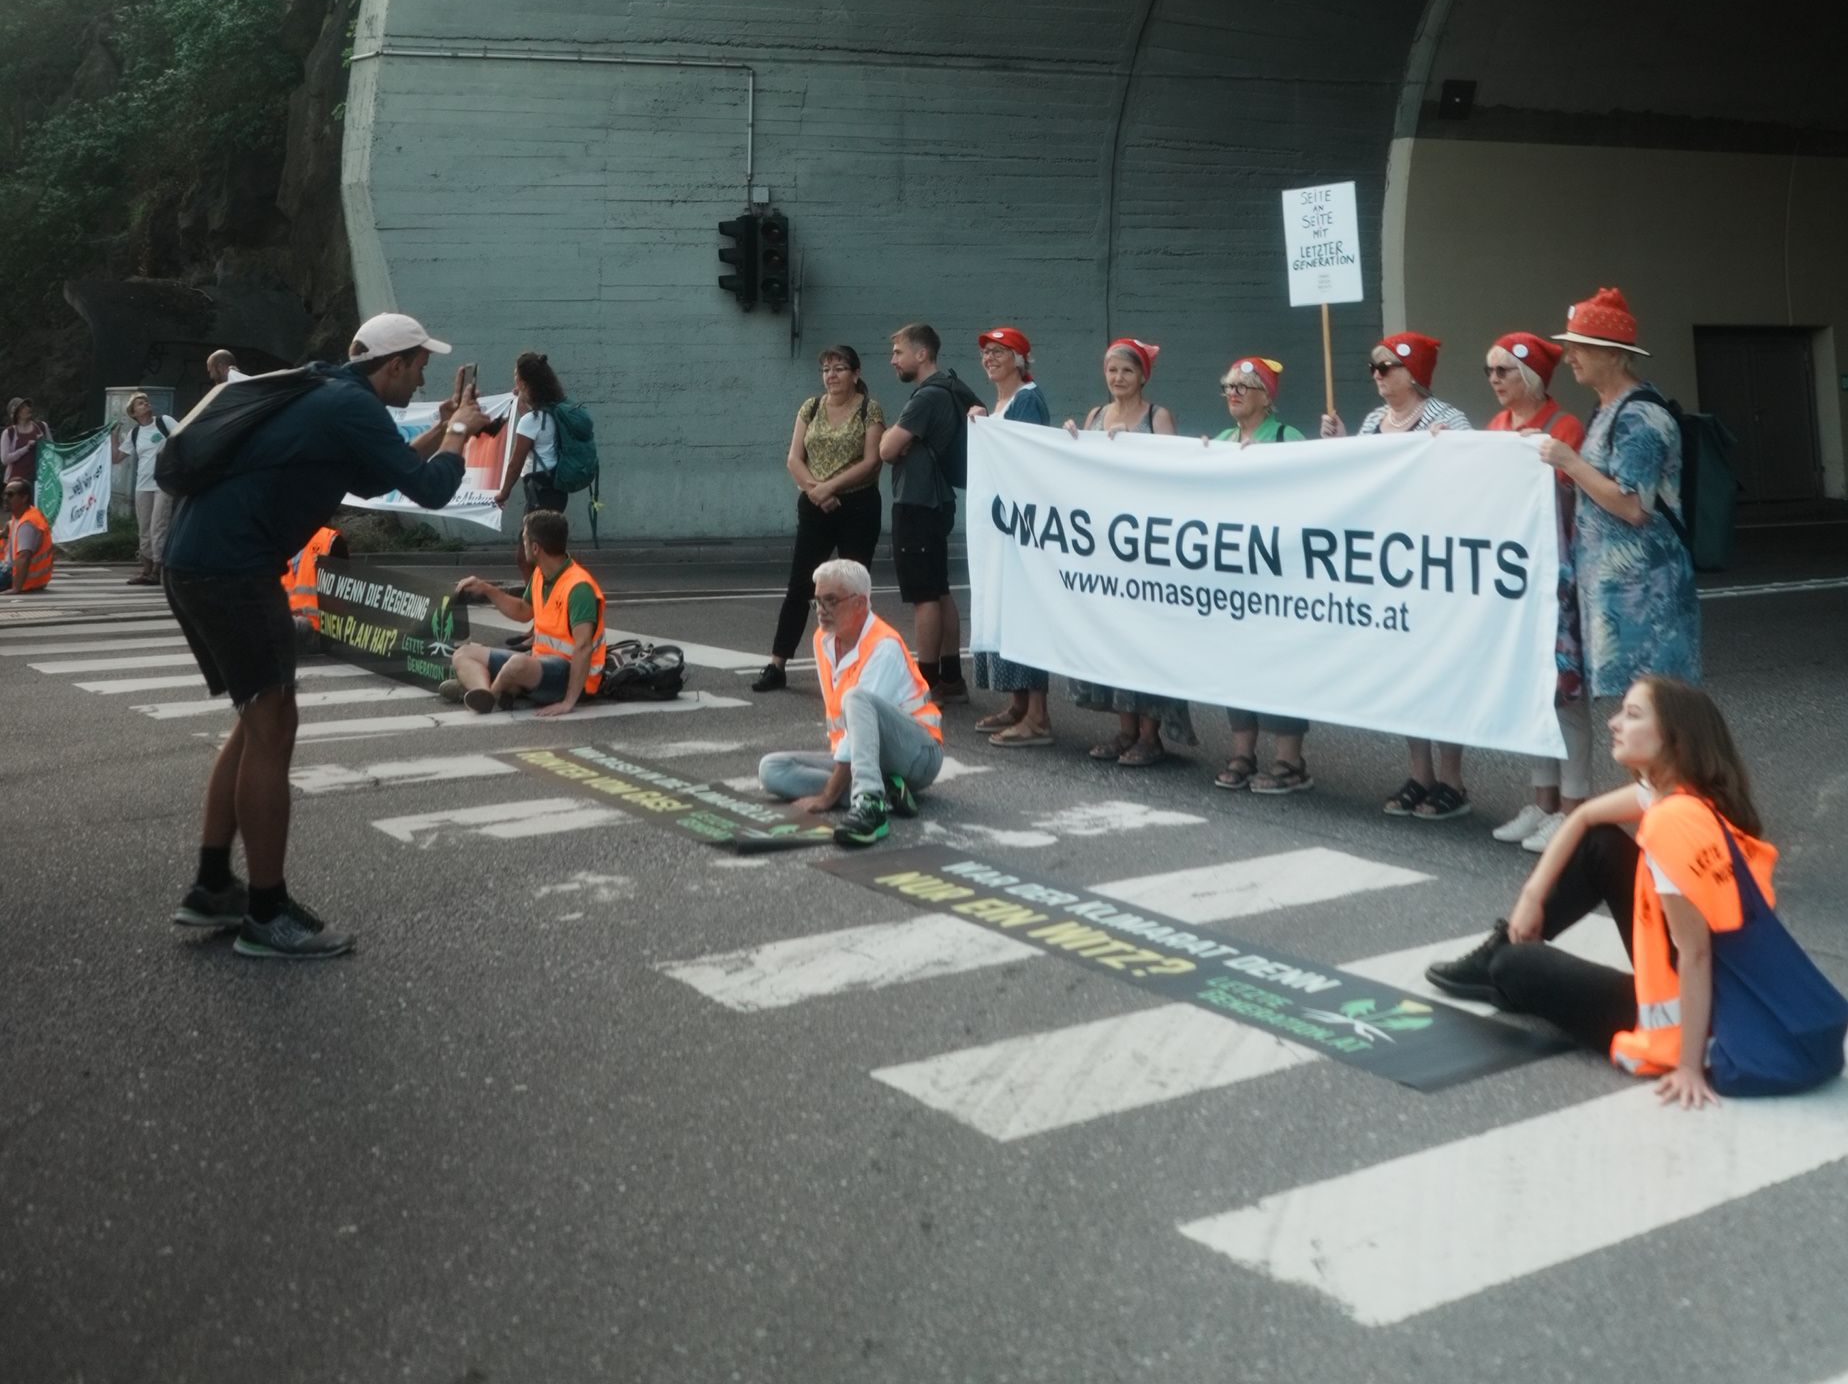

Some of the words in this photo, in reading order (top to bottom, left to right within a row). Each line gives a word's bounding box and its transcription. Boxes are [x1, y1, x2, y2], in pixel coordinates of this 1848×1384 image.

[1292, 255, 1355, 271] GENERATION
[1300, 240, 1344, 259] LETZTER
[1107, 512, 1283, 578] GEGEN
[1303, 527, 1531, 601] RECHTS
[317, 568, 335, 595] UND
[334, 576, 367, 603] WENN
[364, 582, 384, 608] DIE
[381, 584, 430, 622] REGIERUNG
[1058, 567, 1412, 634] www.omasgegenrechts.at
[320, 610, 343, 639] EINEN
[343, 615, 373, 652] PLAN
[369, 625, 398, 657] HAT?
[401, 634, 425, 655] LETZTE
[406, 655, 445, 681] GENERATION
[874, 871, 975, 902] NUR
[951, 898, 1049, 928] EIN
[1026, 920, 1197, 977] WITZ?
[941, 860, 1020, 887] WAR
[1004, 883, 1080, 906] DER
[1064, 900, 1240, 958] KLIMARAT
[1222, 954, 1343, 994] DENN
